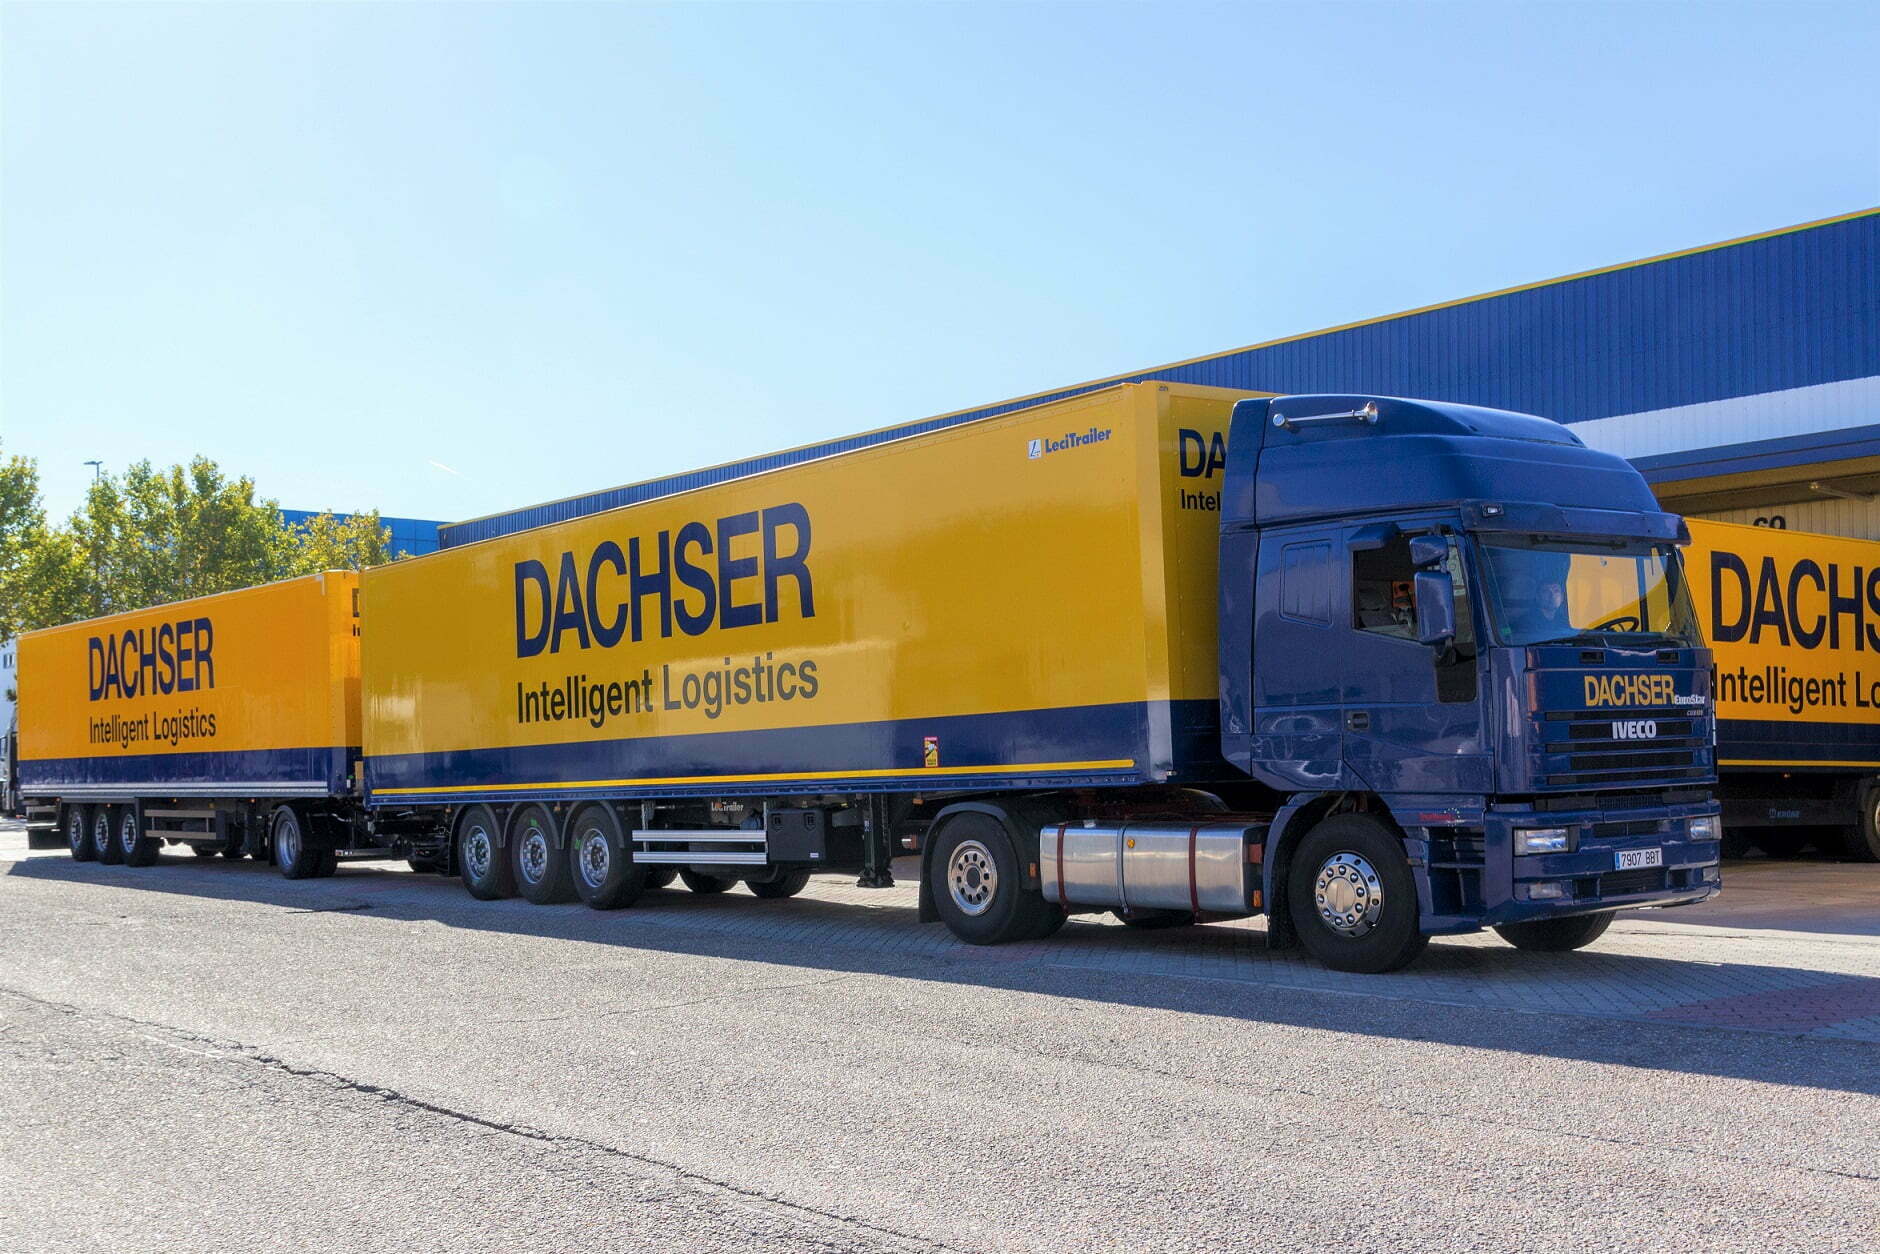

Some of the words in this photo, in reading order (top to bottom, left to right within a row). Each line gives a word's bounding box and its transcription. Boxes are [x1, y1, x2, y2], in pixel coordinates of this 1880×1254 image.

[1045, 427, 1112, 453] LeciTrailer
[514, 502, 815, 659] DACHSER
[88, 617, 215, 701] DACHSER
[517, 669, 653, 728] Intelligent
[663, 652, 819, 719] Logistics
[1584, 675, 1675, 707] DACHSER
[1713, 663, 1847, 714] Intelligent
[89, 711, 149, 749] Intelligent
[154, 707, 217, 746] Logistics
[1612, 721, 1657, 740] IVECO
[1621, 852, 1642, 867] 7907
[1645, 850, 1660, 865] BBT
